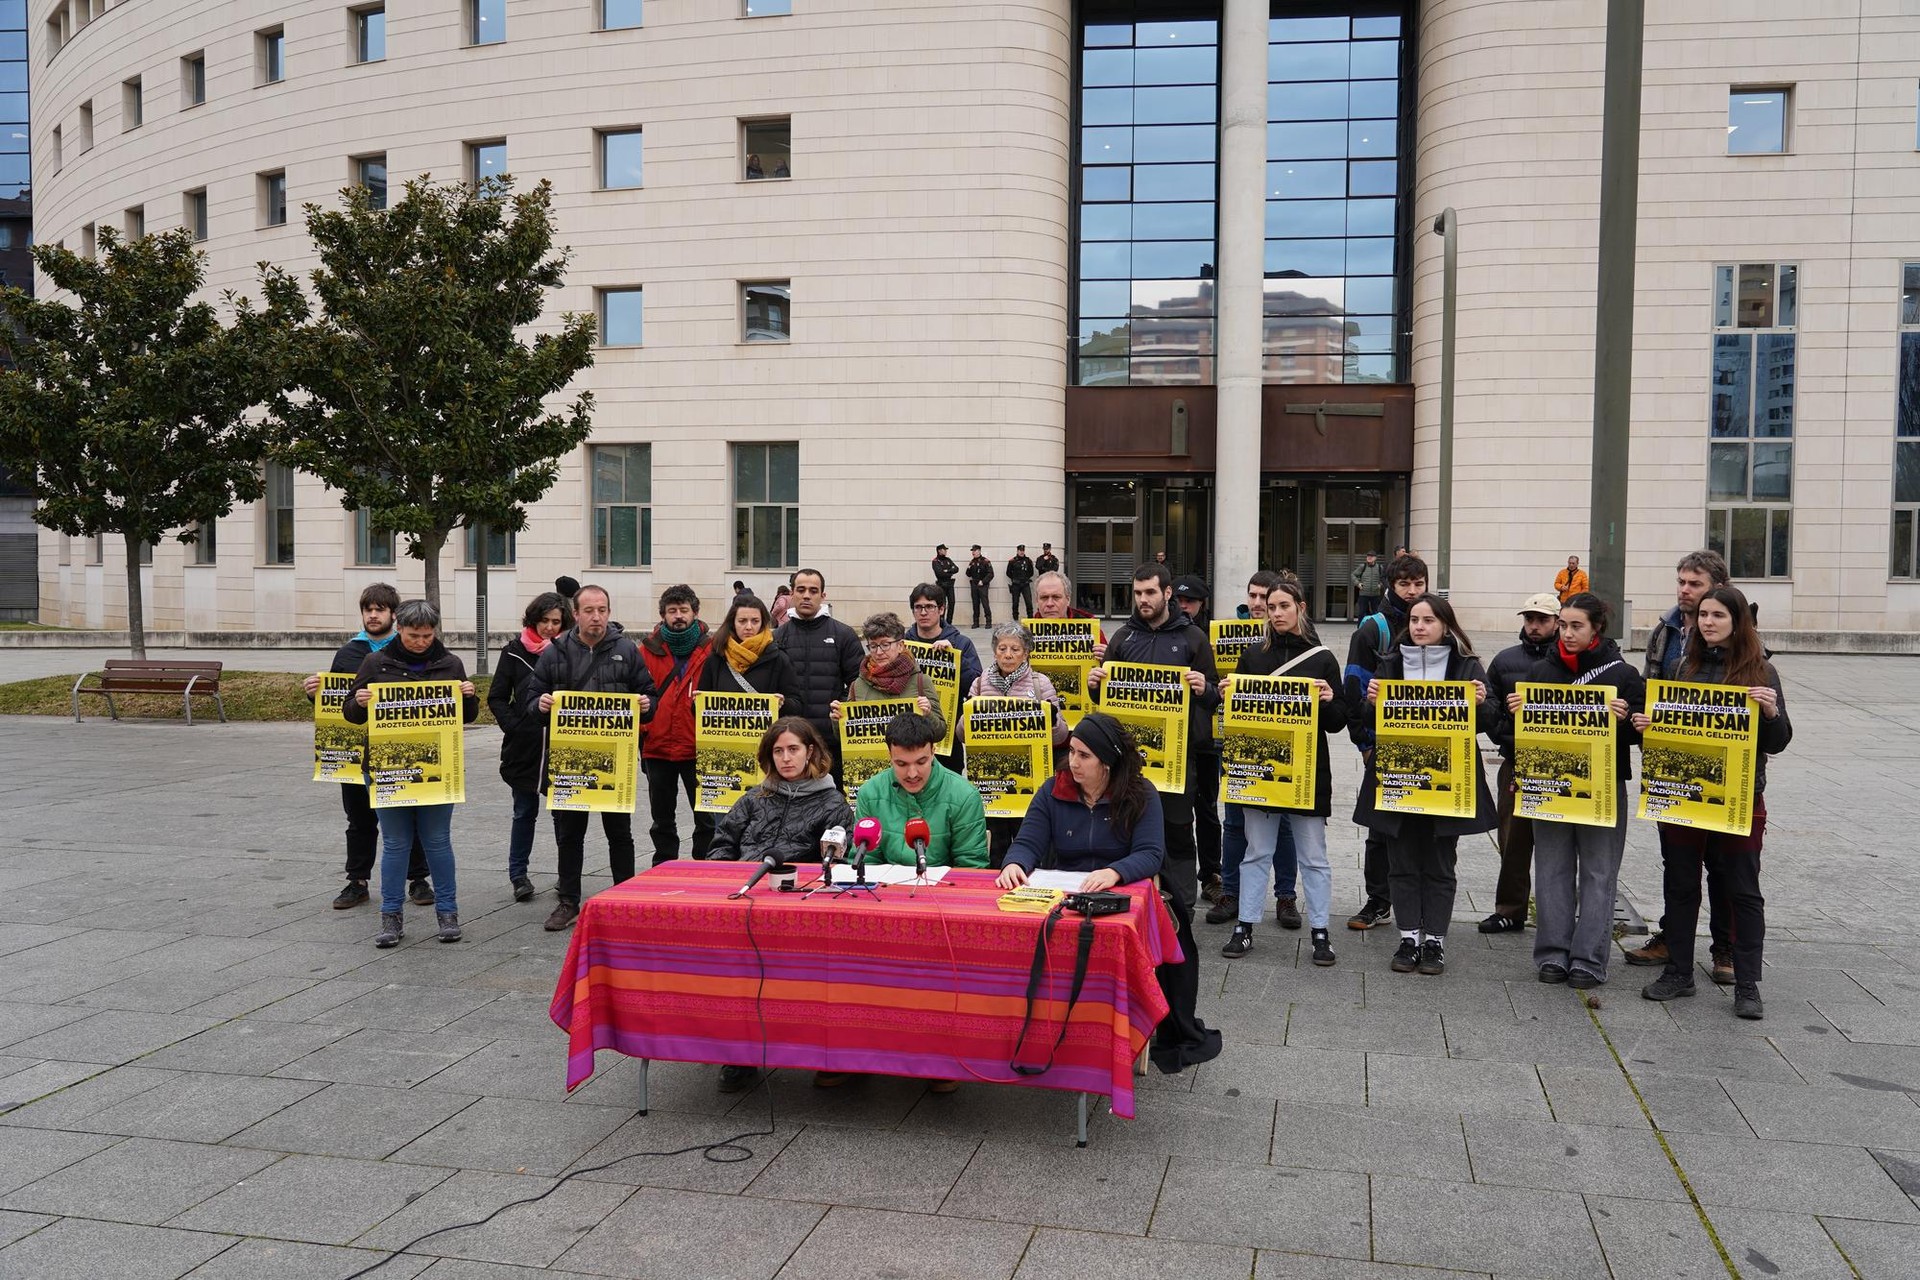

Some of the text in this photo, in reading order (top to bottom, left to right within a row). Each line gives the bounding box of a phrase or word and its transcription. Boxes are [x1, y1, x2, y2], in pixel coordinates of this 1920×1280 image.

[1030, 623, 1091, 636] LURRAREN
[1219, 624, 1263, 638] LURRA
[920, 665, 956, 681] NTSAN
[1111, 666, 1180, 684] LURRAREN
[932, 680, 955, 688] ELDITU!
[1236, 678, 1309, 696] LURRAREN
[378, 686, 452, 702] LURRAREN
[1106, 687, 1183, 705] DEFENTSAN
[1387, 684, 1464, 700] LURRAREN
[1526, 688, 1604, 705] LURRAREN
[1658, 686, 1746, 708] LURRAREN
[376, 699, 442, 708] KRIMINALIZAZIORIK
[562, 696, 630, 710] LURRAREN
[705, 696, 770, 711] LURRAREN
[972, 700, 1041, 714] LURRAREN
[1106, 702, 1182, 713] AROZTEGIA GELDITU!
[1231, 700, 1312, 717] DEFENTSAN
[1654, 704, 1733, 713] KRIMINALIZAZIORIK
[376, 703, 456, 720] DEFENTSAN
[971, 712, 1032, 720] KRIMINALIZAZIORIK
[1384, 706, 1468, 722] DEFENTSAN
[558, 716, 632, 730] DEFENTSAN
[702, 716, 772, 730] DEFENTSAN
[970, 716, 1046, 732] DEFENTSAN
[1231, 714, 1312, 726] AROZTEGIA GELDITU!
[1523, 710, 1608, 728] DEFENTSAN
[1652, 710, 1750, 732] DEFENTSAN
[846, 723, 886, 737] DEFEN
[1523, 726, 1610, 736] AROZTEGIA GELDITU!
[1652, 726, 1749, 741] AROZTEGIA GELDITU!
[1228, 763, 1274, 772] MANIFESTAZIO
[1522, 778, 1571, 786] MANIFESTAZIO
[1648, 780, 1702, 792] MANIFESTAZIO
[1648, 787, 1691, 798] NAZIONALA
